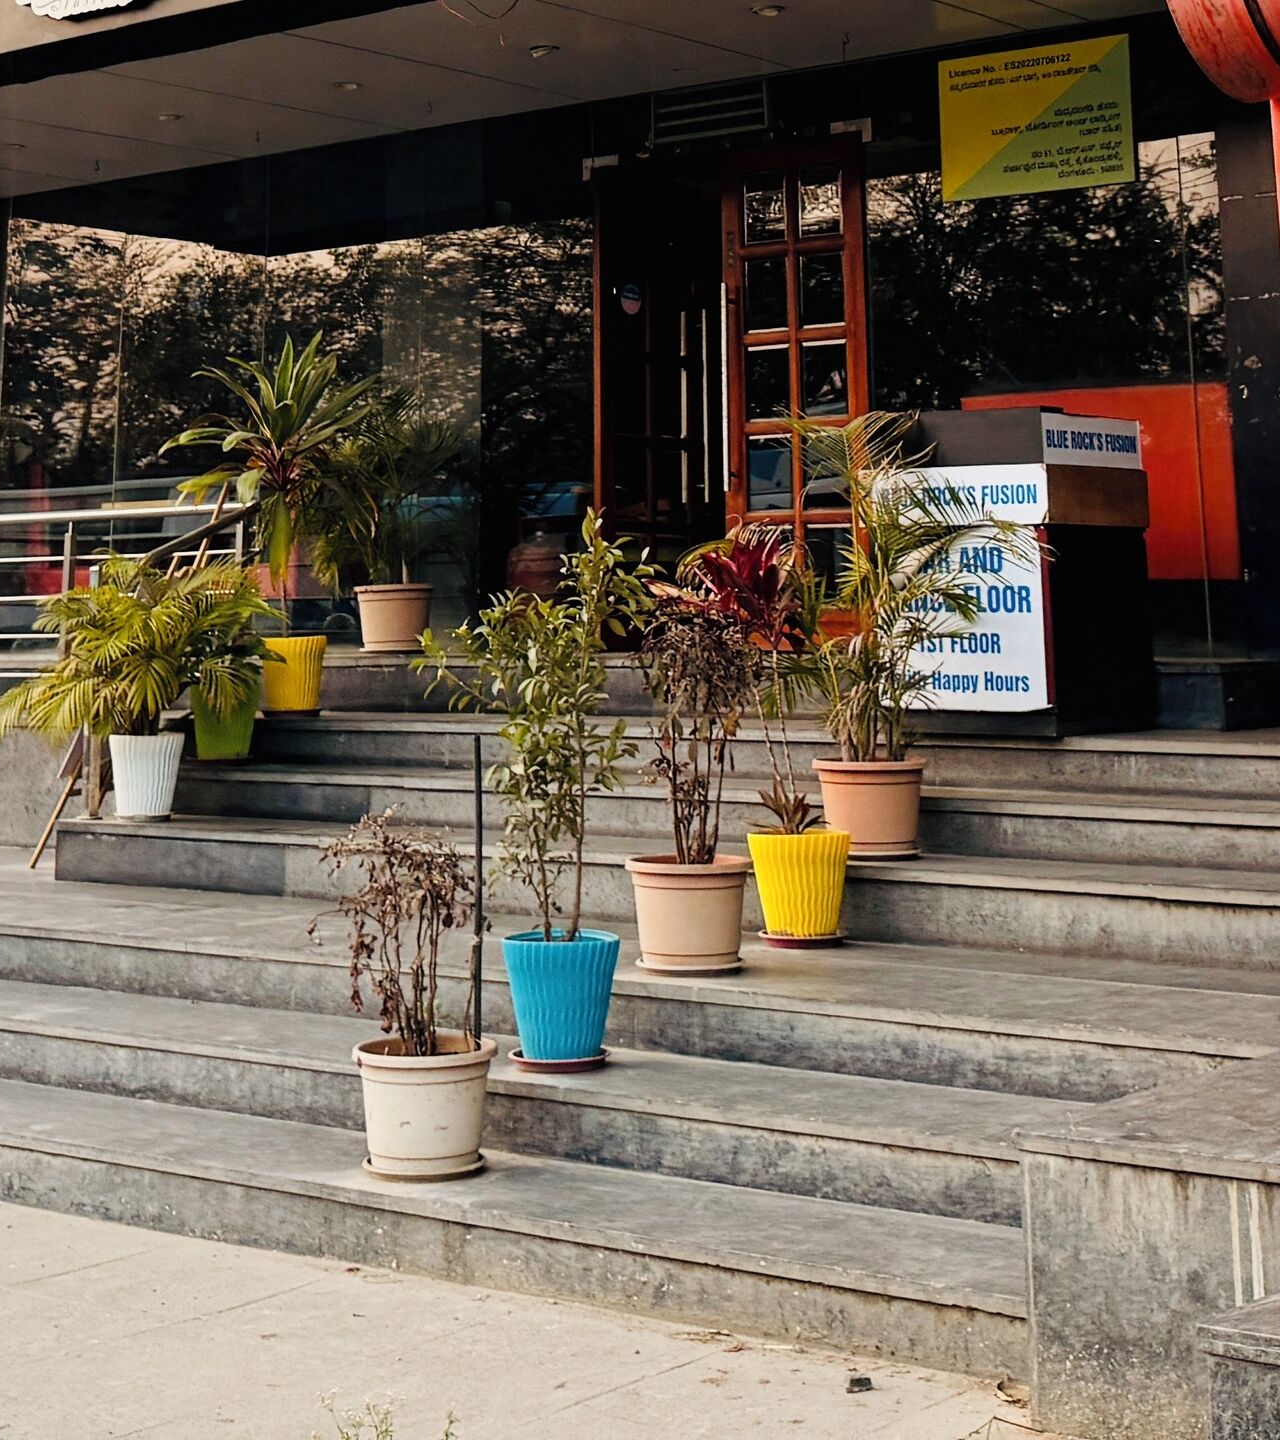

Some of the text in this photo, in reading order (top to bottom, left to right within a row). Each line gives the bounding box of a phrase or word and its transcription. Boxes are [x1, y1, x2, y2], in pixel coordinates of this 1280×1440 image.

[1046, 428, 1138, 454] BLUE ROCK'S FUSION
[981, 483, 1038, 505] FUSION
[958, 546, 1004, 574] AND
[951, 633, 1001, 654] FLOOR
[932, 671, 979, 693] Happy
[984, 671, 1030, 693] Hours
